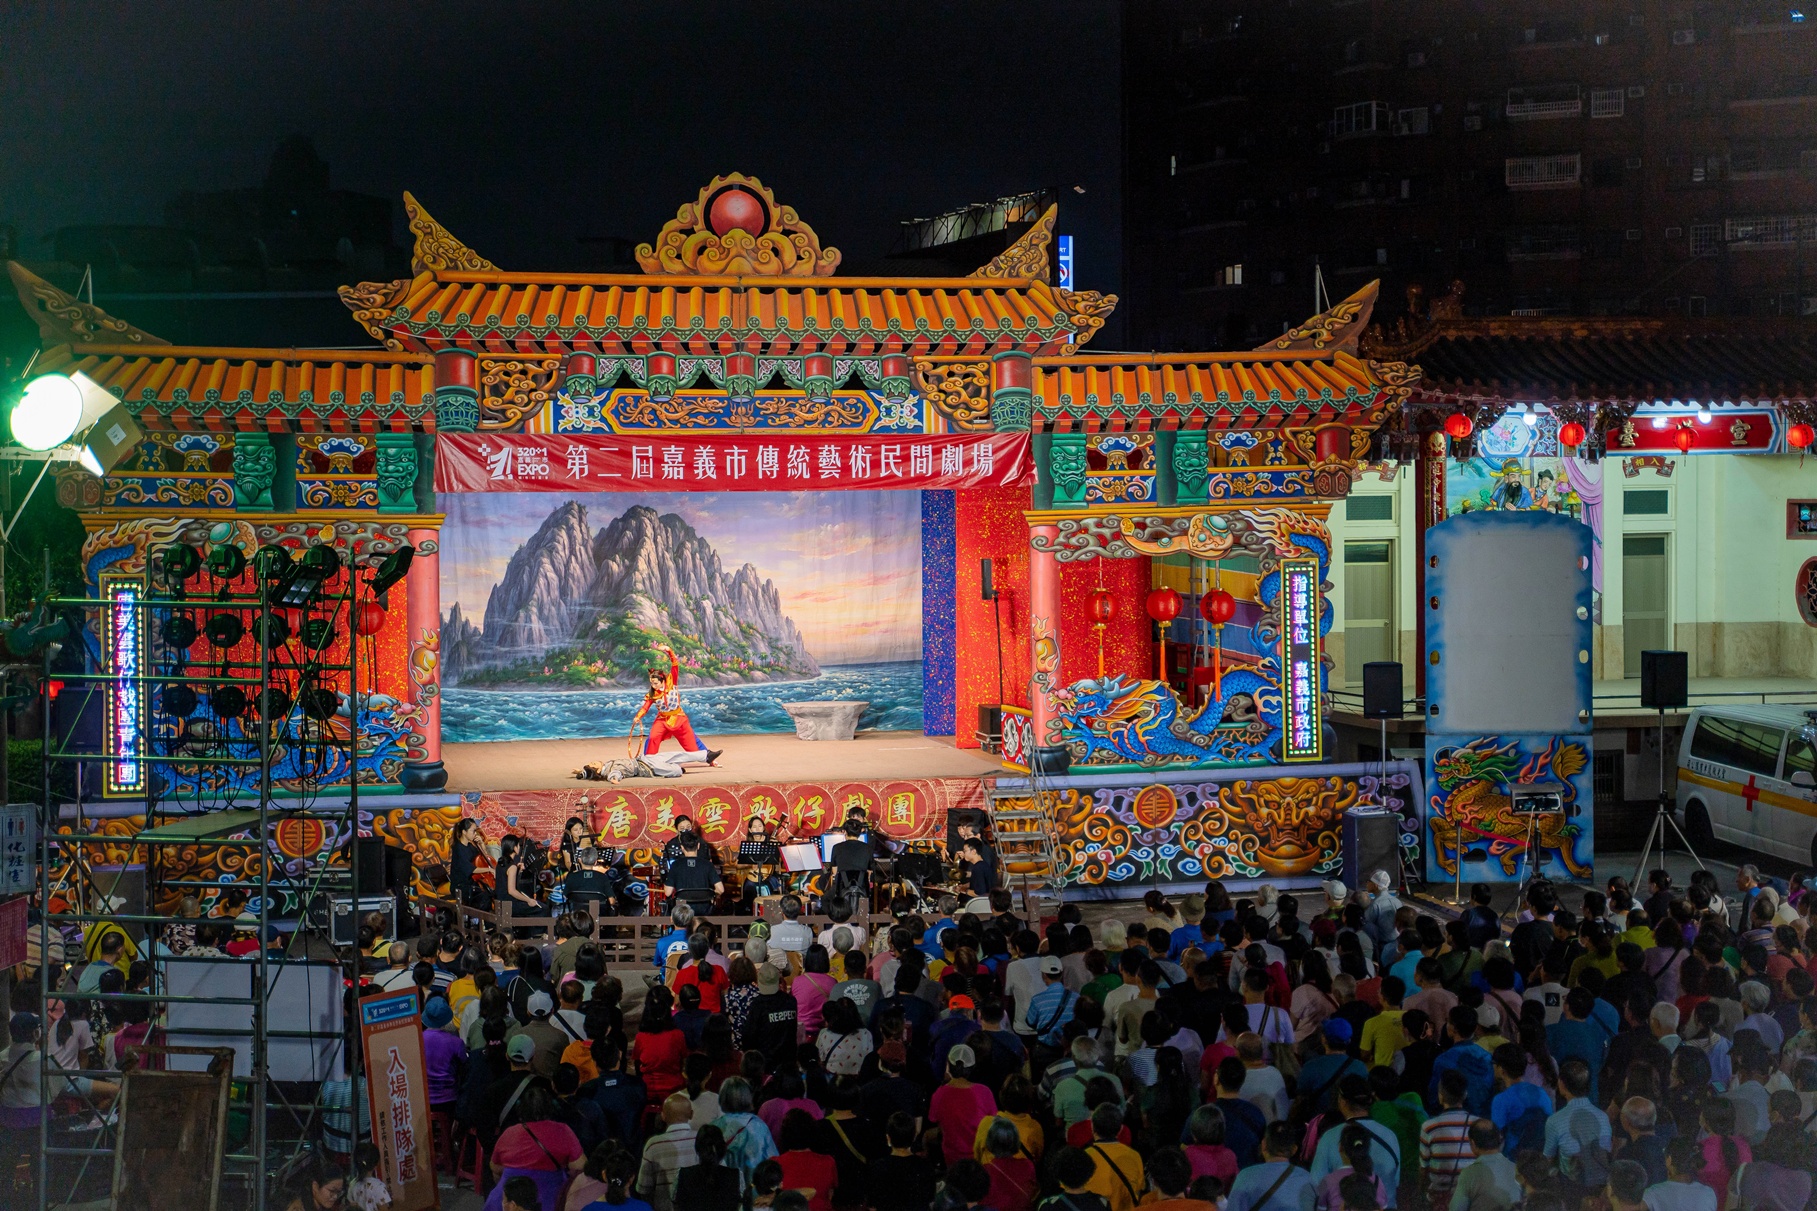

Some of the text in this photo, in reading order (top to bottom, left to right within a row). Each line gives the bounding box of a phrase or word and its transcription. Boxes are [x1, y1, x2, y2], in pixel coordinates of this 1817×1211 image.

[517, 463, 549, 475] EXPO
[565, 443, 994, 480] 第二屆嘉義市傳統藝術民間劇場
[1292, 575, 1311, 748] 指導單位 嘉義市政府
[598, 792, 915, 842] 唐美雲歌仔戲團
[388, 1047, 416, 1183] 入場排隊處
